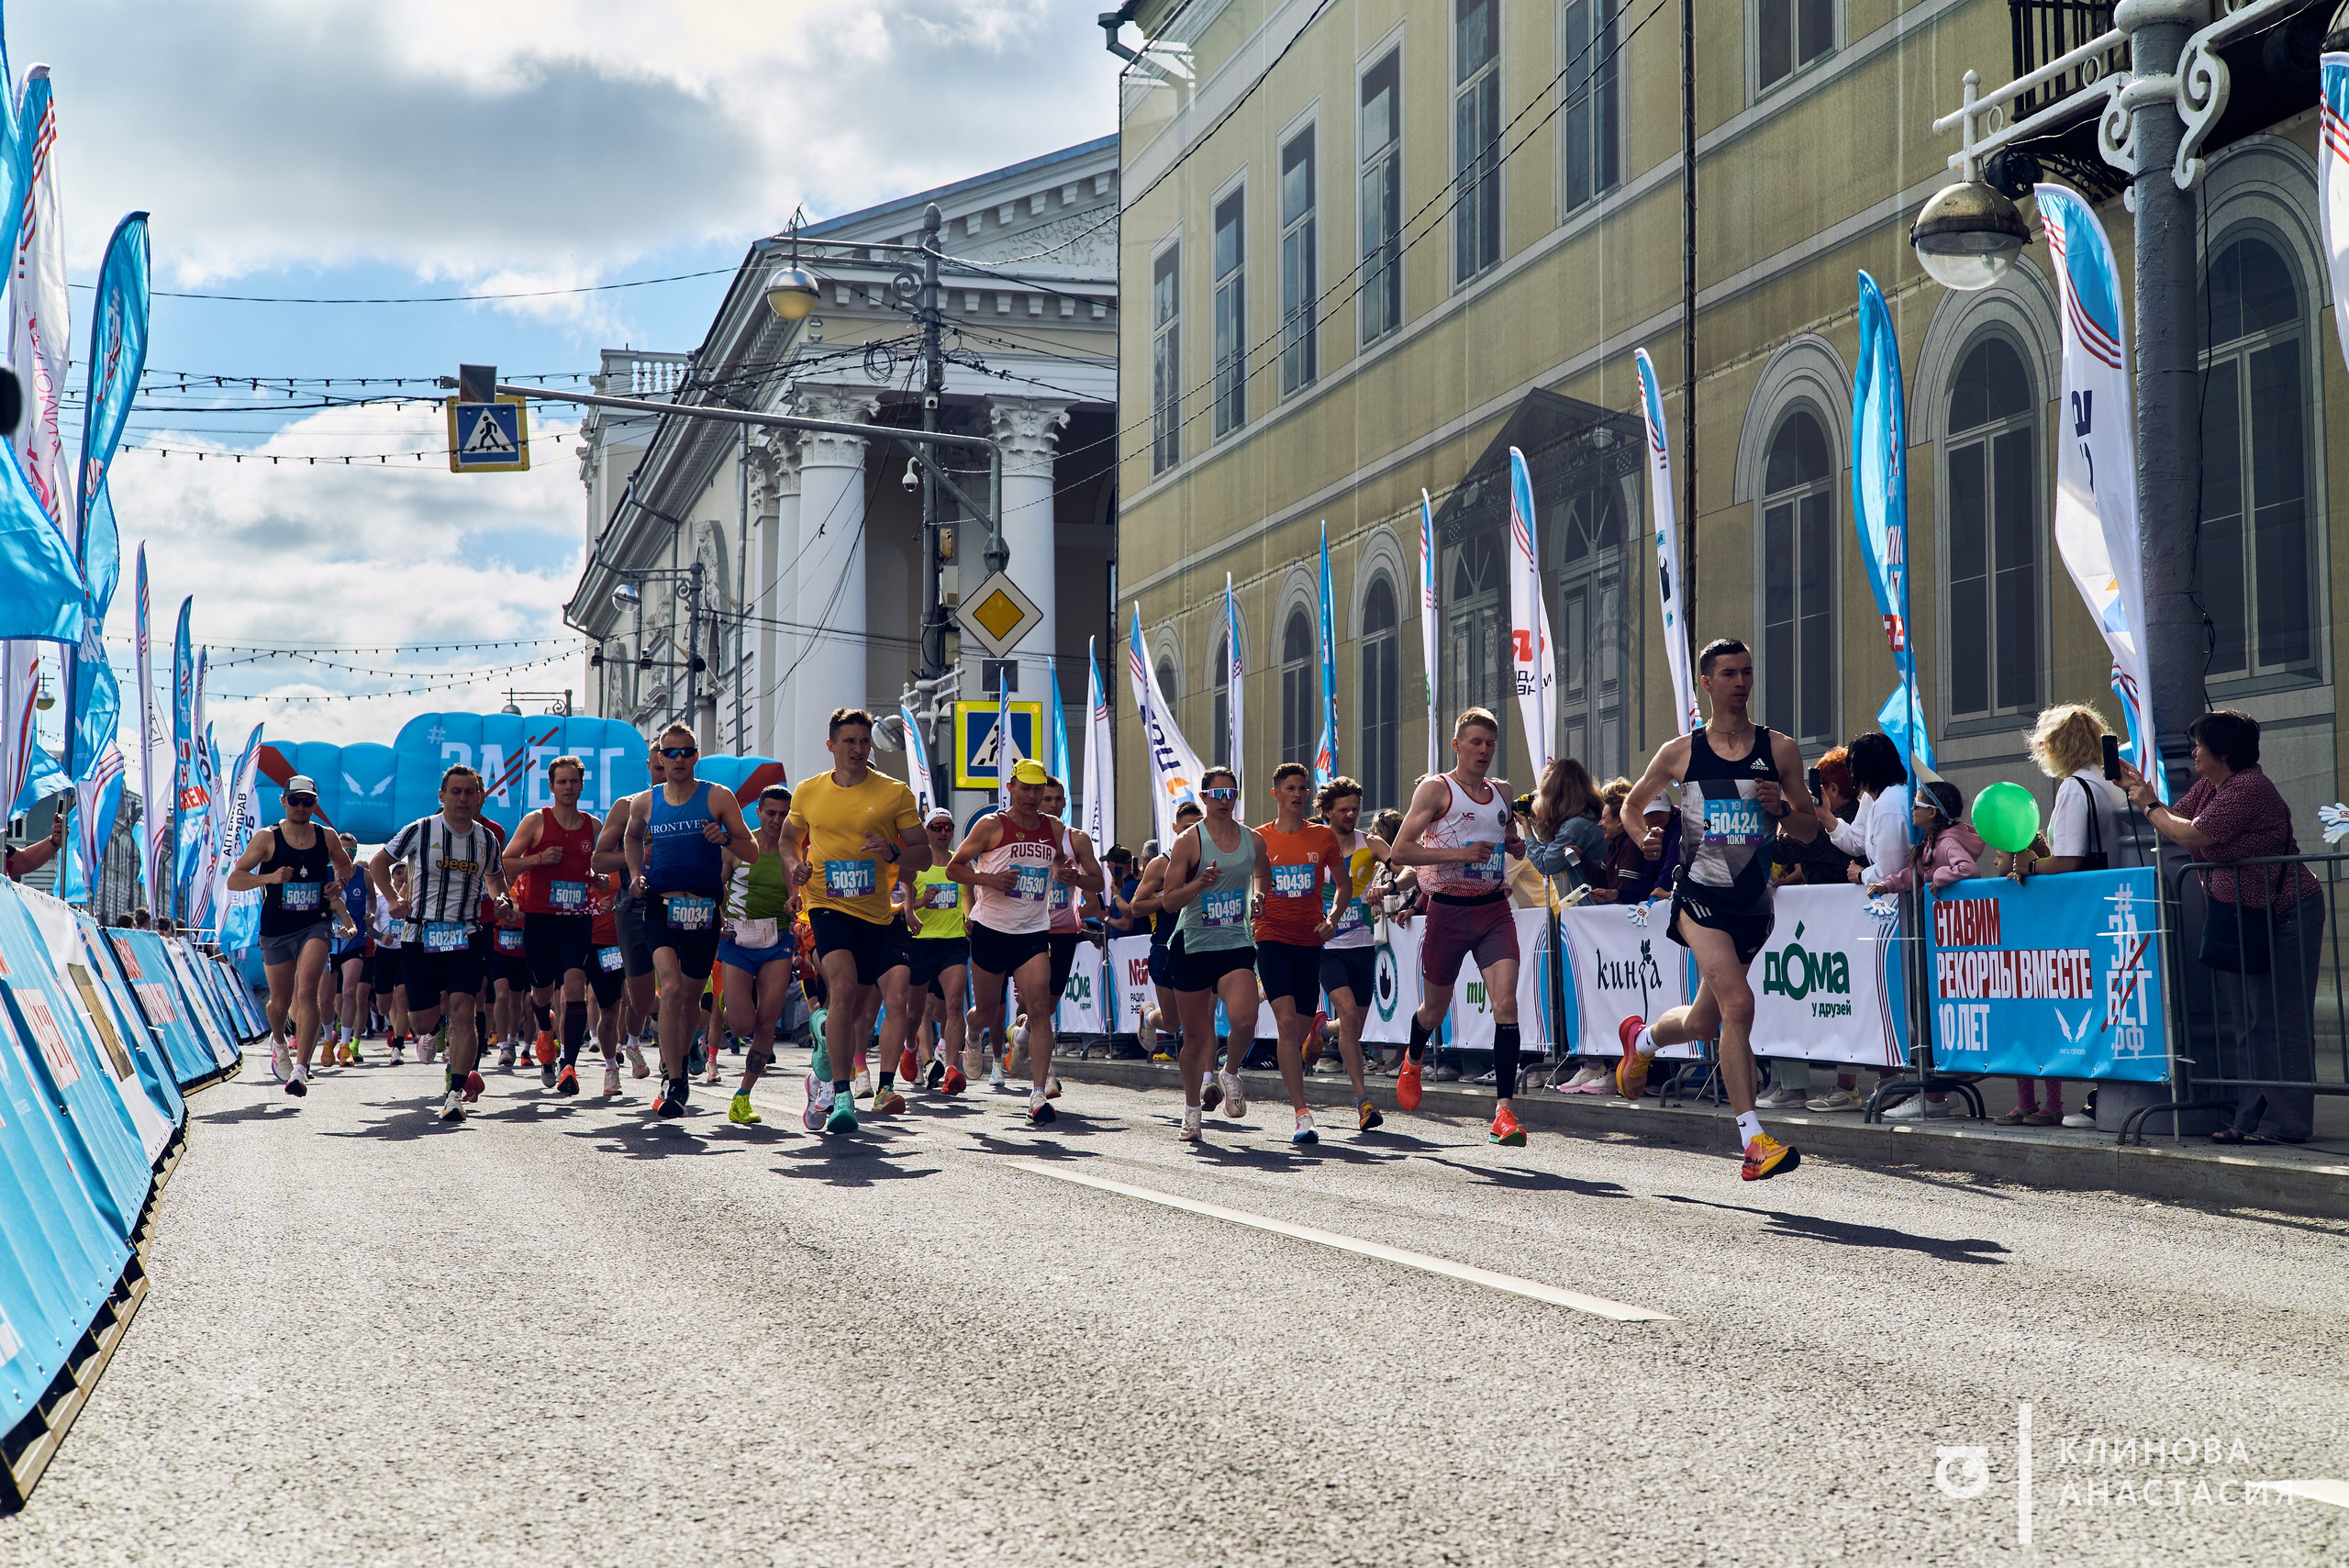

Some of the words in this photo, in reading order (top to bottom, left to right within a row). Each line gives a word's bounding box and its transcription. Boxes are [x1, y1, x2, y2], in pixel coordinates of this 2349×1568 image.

[1709, 812, 1759, 834] 50424
[1010, 843, 1052, 862] RUSSIA
[1307, 851, 1319, 863] 10
[436, 853, 480, 875] Jeep
[832, 869, 868, 889] 50371
[1275, 873, 1311, 890] 50436
[286, 890, 317, 905] 50345
[556, 889, 582, 904] 50119
[930, 890, 956, 904] 0005
[673, 906, 707, 923] 50034
[1207, 898, 1241, 919] 50495
[1933, 898, 2001, 948] СТАВИМ
[429, 929, 462, 947] 50287
[500, 935, 522, 946] 50444
[2109, 914, 2145, 970] ЗА
[602, 951, 623, 967] 5056
[1936, 950, 2019, 999] РЕКОРДЫ
[2019, 948, 2093, 999] ВМЕСТЕ
[1130, 993, 1145, 1003] РАДИО
[2106, 970, 2153, 1026] БЕГ
[1819, 999, 1852, 1018] друзей
[1938, 1005, 1956, 1051] 10
[1957, 1004, 1990, 1051] ЛЕТ
